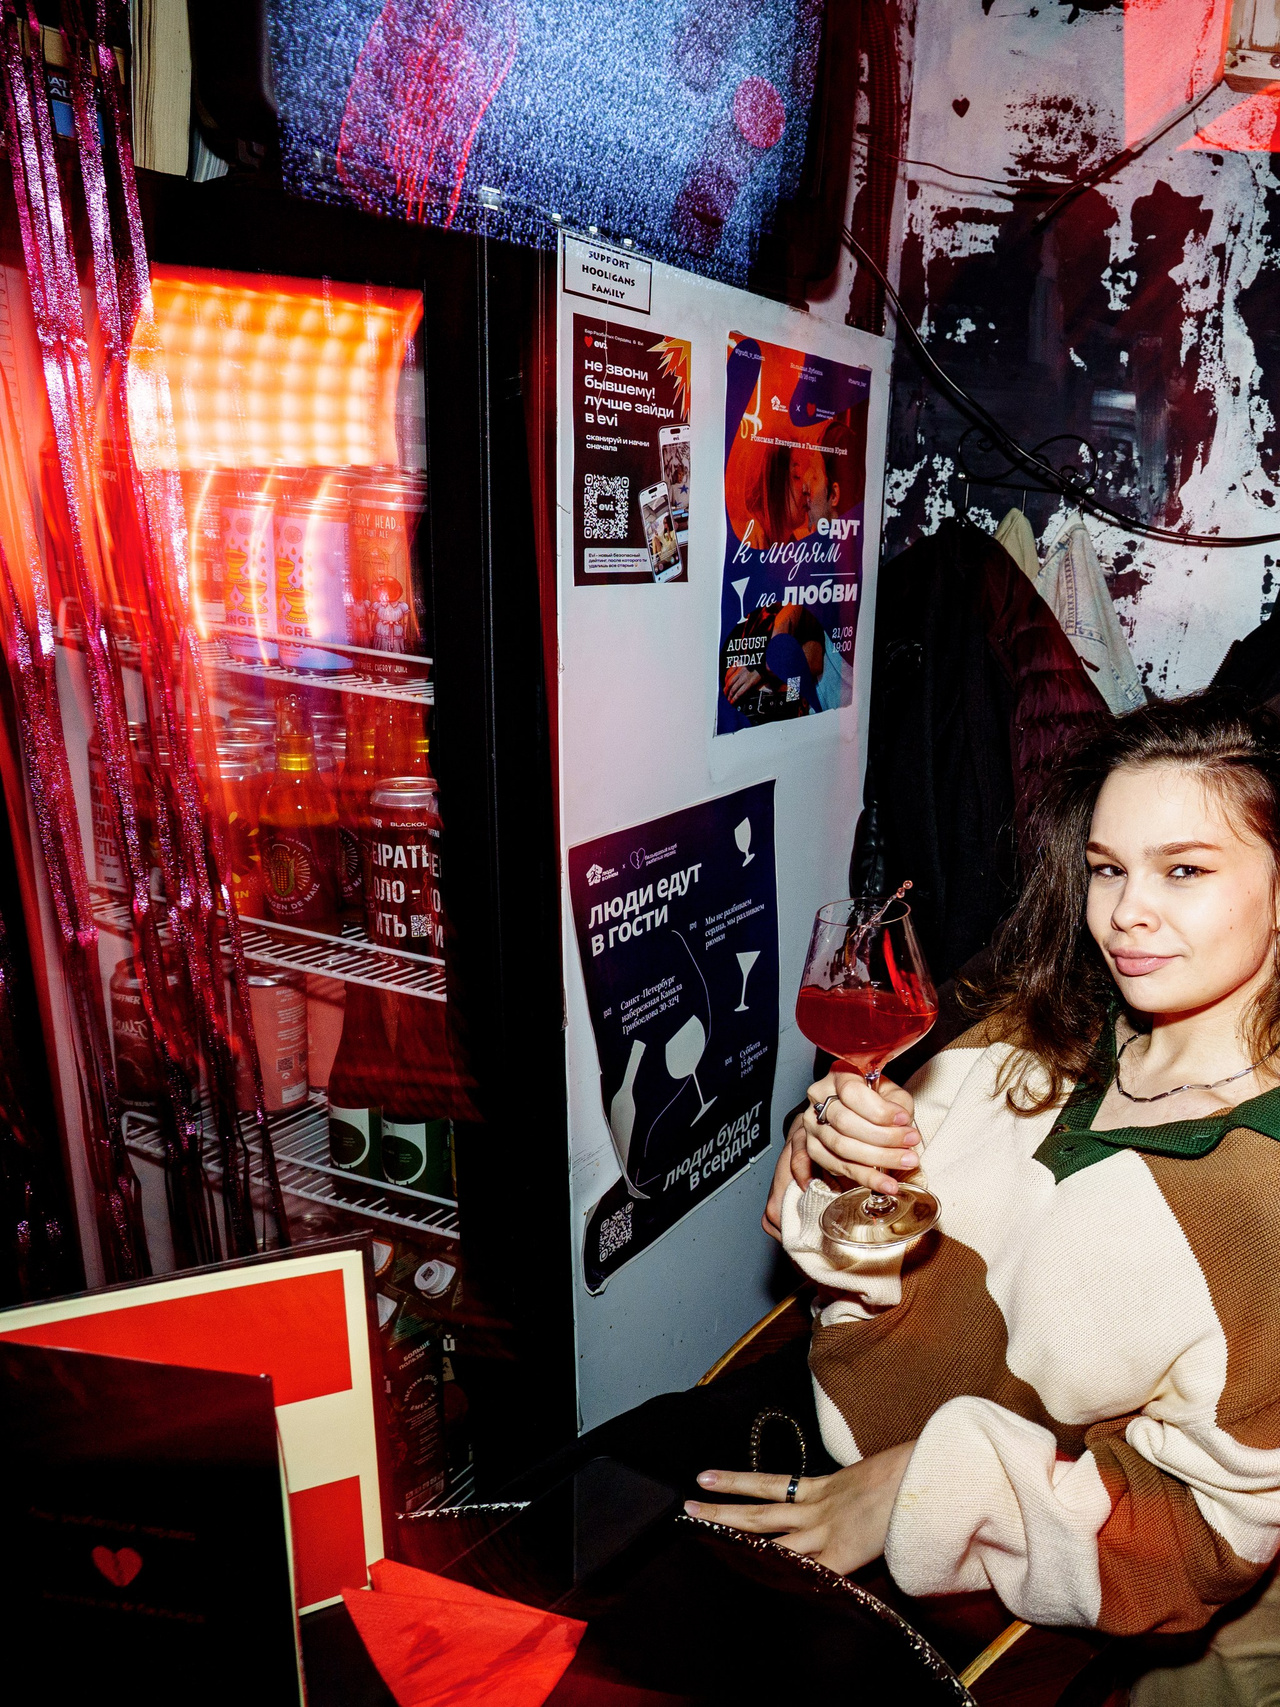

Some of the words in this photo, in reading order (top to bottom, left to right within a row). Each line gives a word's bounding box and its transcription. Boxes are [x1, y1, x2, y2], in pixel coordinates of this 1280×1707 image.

[588, 251, 630, 270] SUPPORT
[582, 264, 635, 287] HOOLIGANS
[592, 283, 625, 299] FAMILY
[584, 359, 603, 372] не
[605, 363, 649, 381] звони
[584, 375, 656, 402] бывшему!
[584, 395, 632, 412] лучше
[634, 402, 674, 419] зайди
[585, 412, 594, 423] в
[597, 413, 618, 427] evi
[585, 434, 622, 445] сканируй
[585, 443, 618, 452] сначала
[598, 501, 615, 512] evi
[374, 514, 396, 530] HEAD
[817, 517, 861, 540] едут
[759, 541, 842, 582] людям
[781, 579, 858, 607] любви
[831, 626, 853, 639] 21/08
[727, 636, 767, 652] AUGUST
[831, 640, 852, 654] 19:00
[726, 652, 764, 669] FRIDAY
[656, 862, 702, 901] едут
[290, 900, 304, 910] DE
[303, 882, 321, 902] MAIZ
[620, 994, 640, 1011] Санкт
[621, 996, 660, 1023] набережная
[660, 983, 683, 1001] Канала
[622, 1008, 659, 1036] Грибоедова
[716, 1100, 763, 1147] будут
[702, 1123, 760, 1179] сердце
[402, 1339, 432, 1362] БОЛЬШЕ
